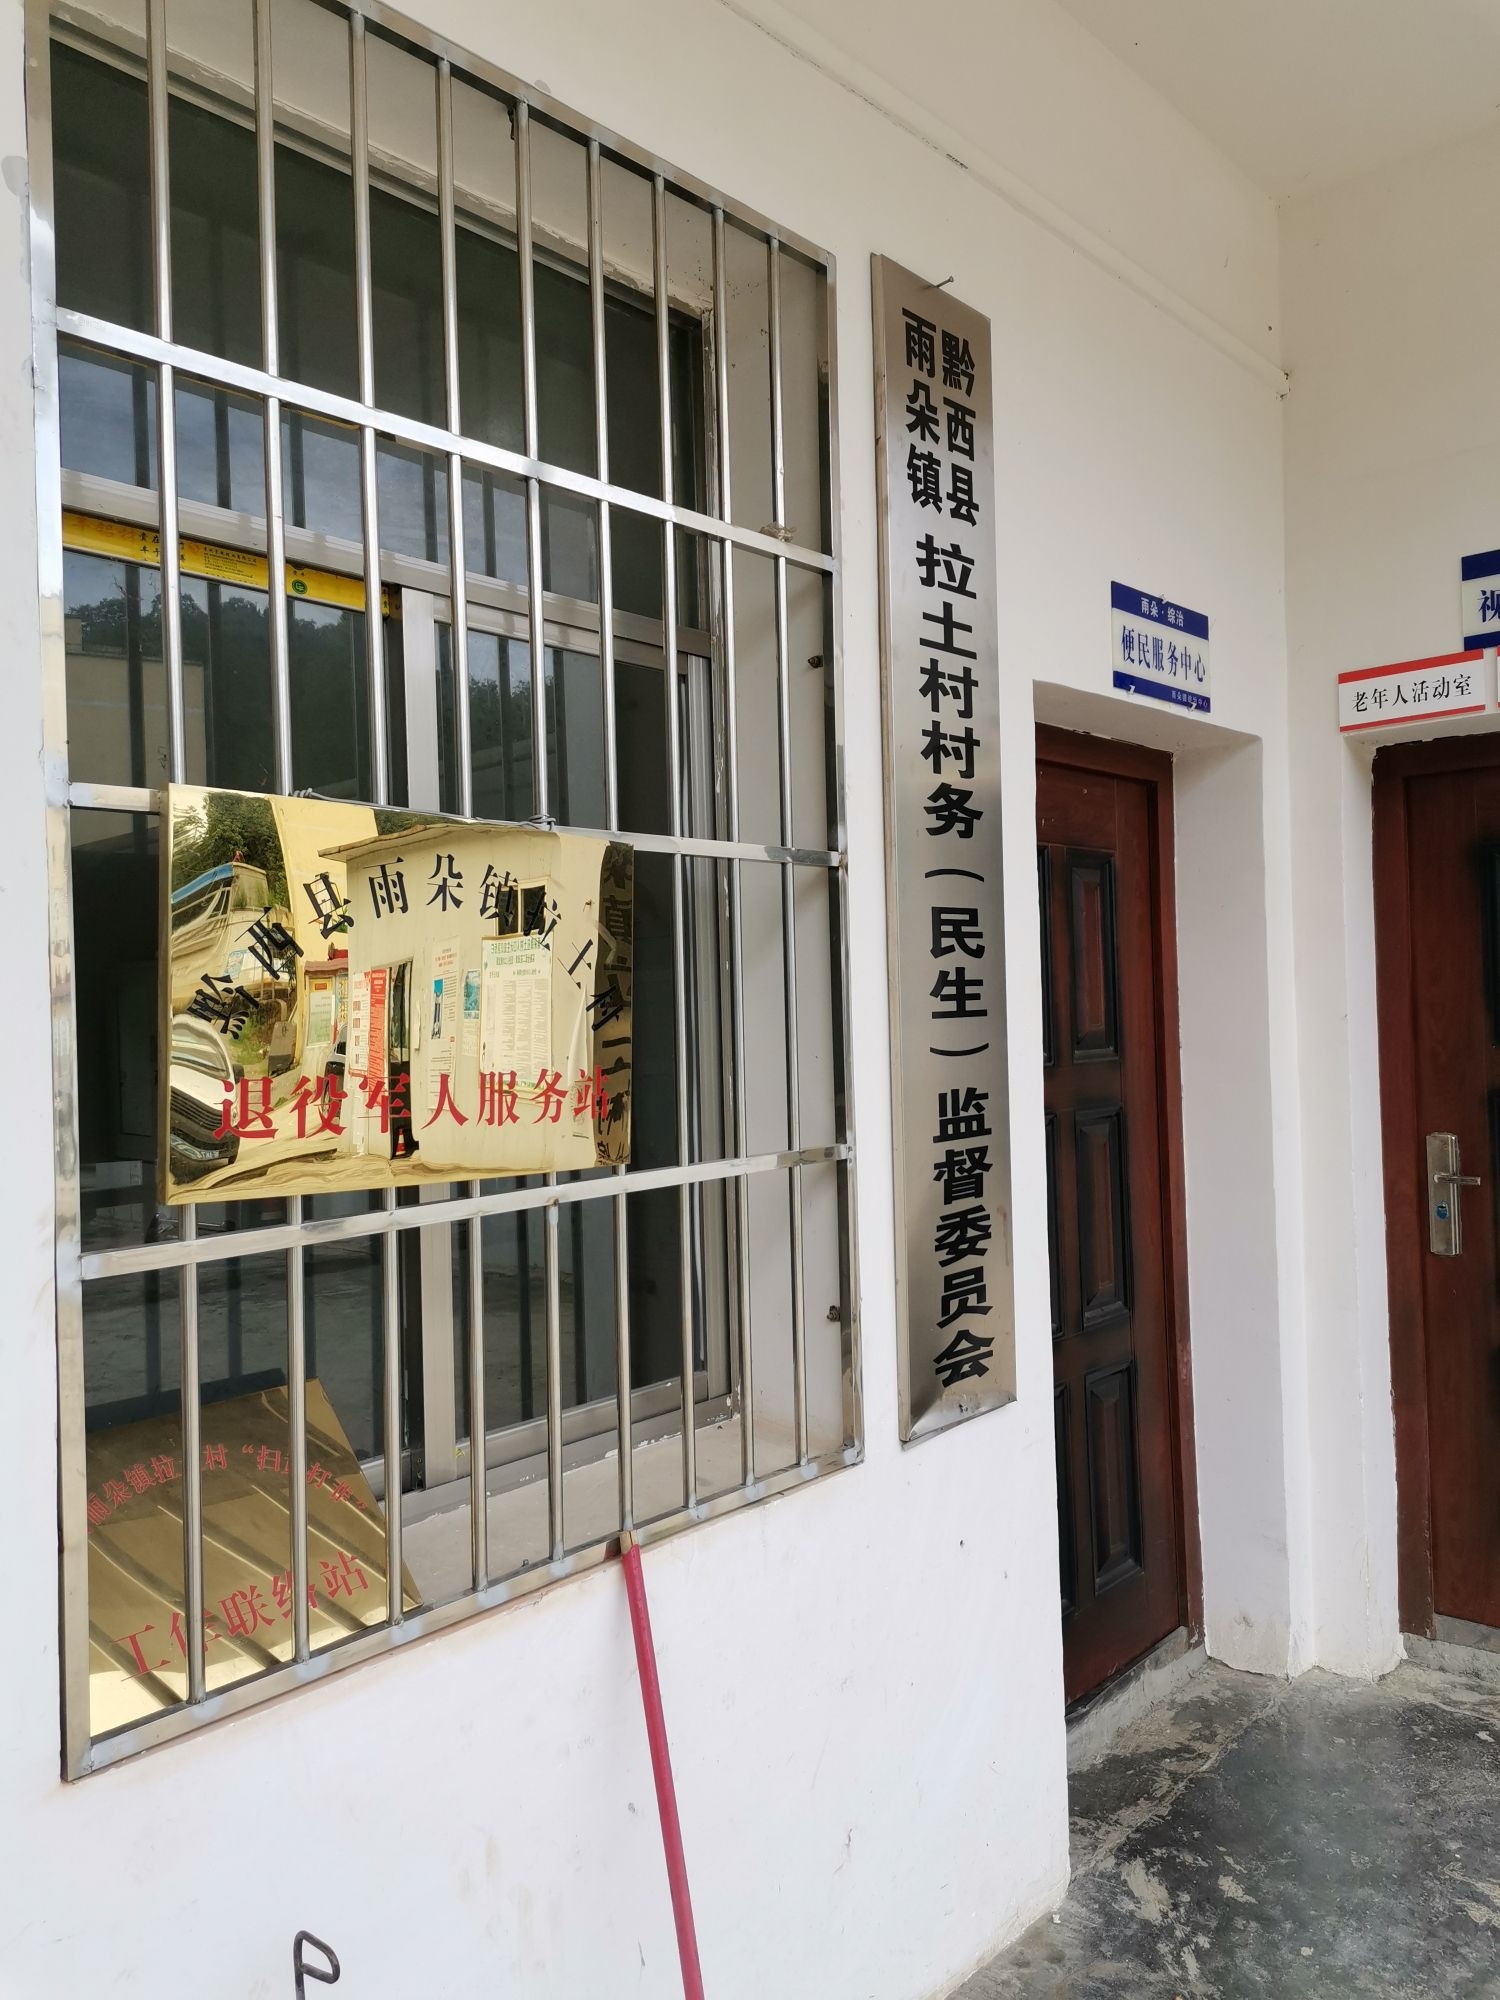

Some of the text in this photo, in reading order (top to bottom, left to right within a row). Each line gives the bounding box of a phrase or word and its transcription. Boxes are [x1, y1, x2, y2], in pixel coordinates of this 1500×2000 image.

[902, 307, 943, 516] 雨朵镇
[941, 328, 980, 528] 黔西县
[1120, 624, 1206, 684] 便民服务中心
[1352, 672, 1472, 712] 老年人活动室
[186, 852, 624, 1040] 黔西县雨朵镇拉土村
[916, 533, 995, 1388] 拉土村村务（民生）监督委员会
[213, 1065, 610, 1142] 退役军人服务站
